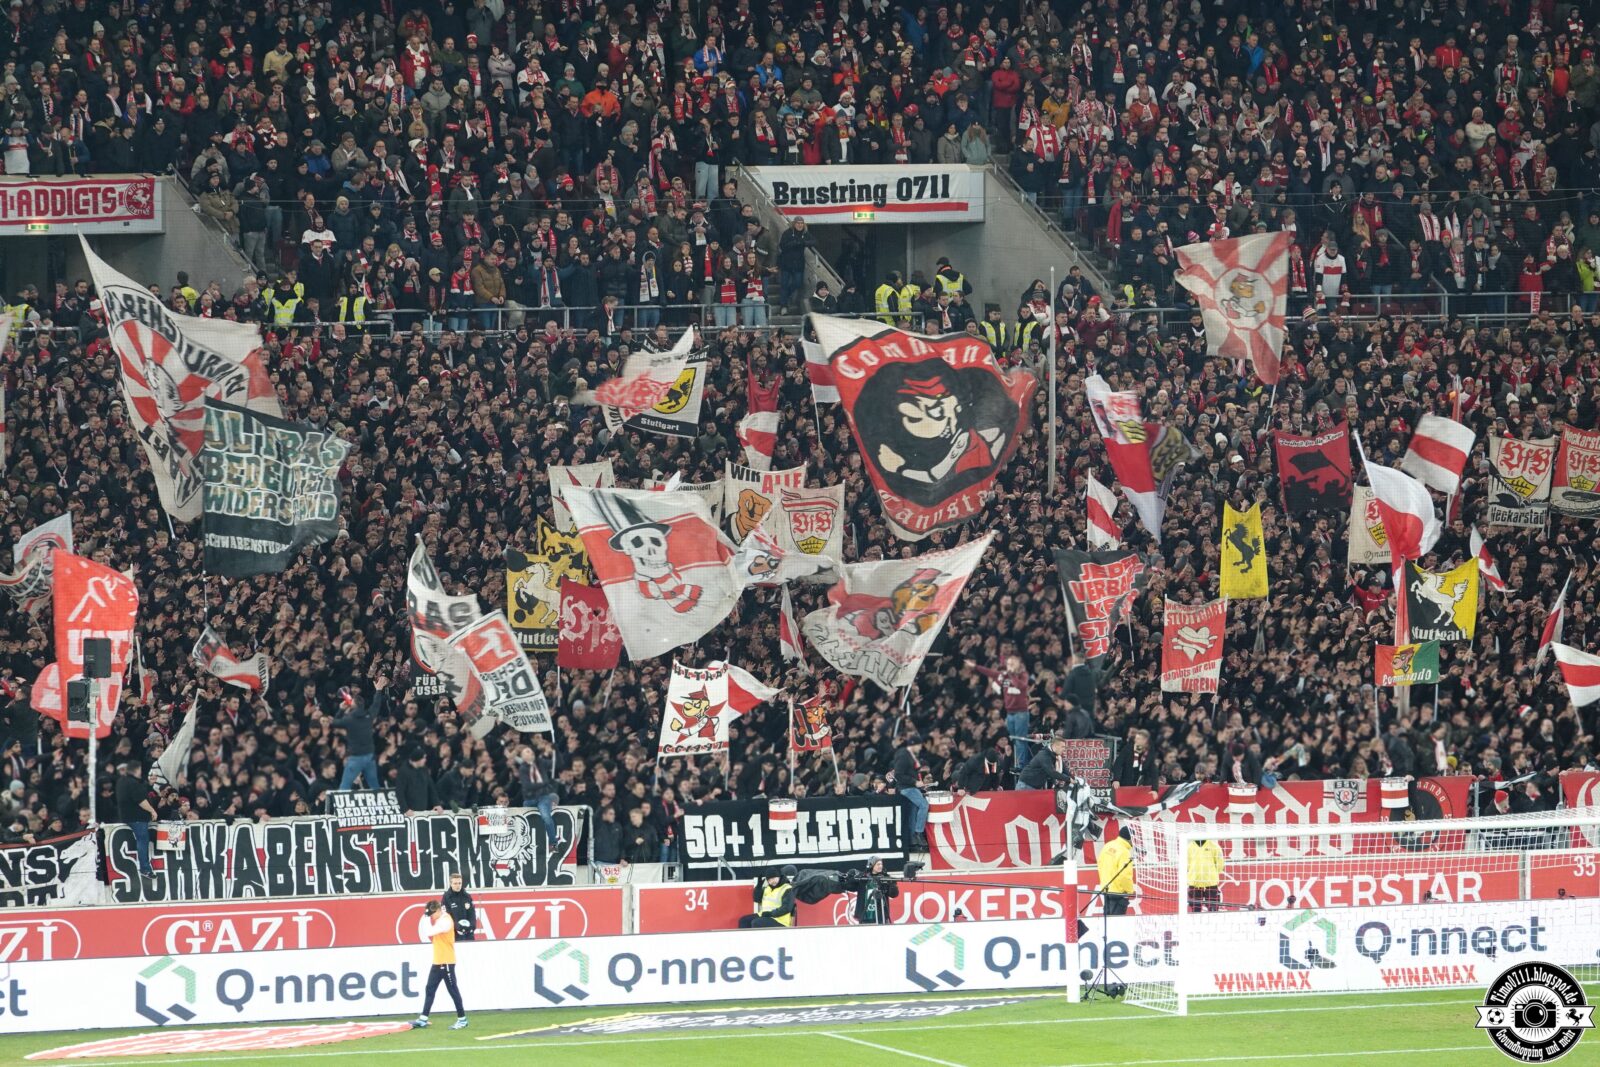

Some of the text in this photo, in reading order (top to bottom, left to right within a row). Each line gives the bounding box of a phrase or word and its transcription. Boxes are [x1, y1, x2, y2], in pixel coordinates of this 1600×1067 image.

[772, 174, 950, 208] Brustring 0711
[641, 417, 679, 430] Stuttgart
[1500, 441, 1551, 475] VfB
[792, 512, 832, 534] VfB
[1412, 626, 1467, 641] Stuttgart
[1382, 668, 1431, 686] Commando
[334, 790, 399, 809] ULTRAS
[336, 804, 401, 818] BEDEUTET
[338, 814, 406, 828] WIDERSTAND
[684, 805, 903, 859] 50+1 BLEIBT!
[1574, 854, 1596, 877] 35
[684, 888, 709, 912] 34
[1245, 870, 1483, 909] JOKERSTAR
[1355, 916, 1548, 964] Q-nnect
[984, 930, 1180, 980] Q-nnect
[608, 947, 795, 994] Q-nnect
[1214, 971, 1312, 993] WINAMAX
[1380, 965, 1478, 987] WINAMAX
[216, 961, 420, 1013] Q-nnect
